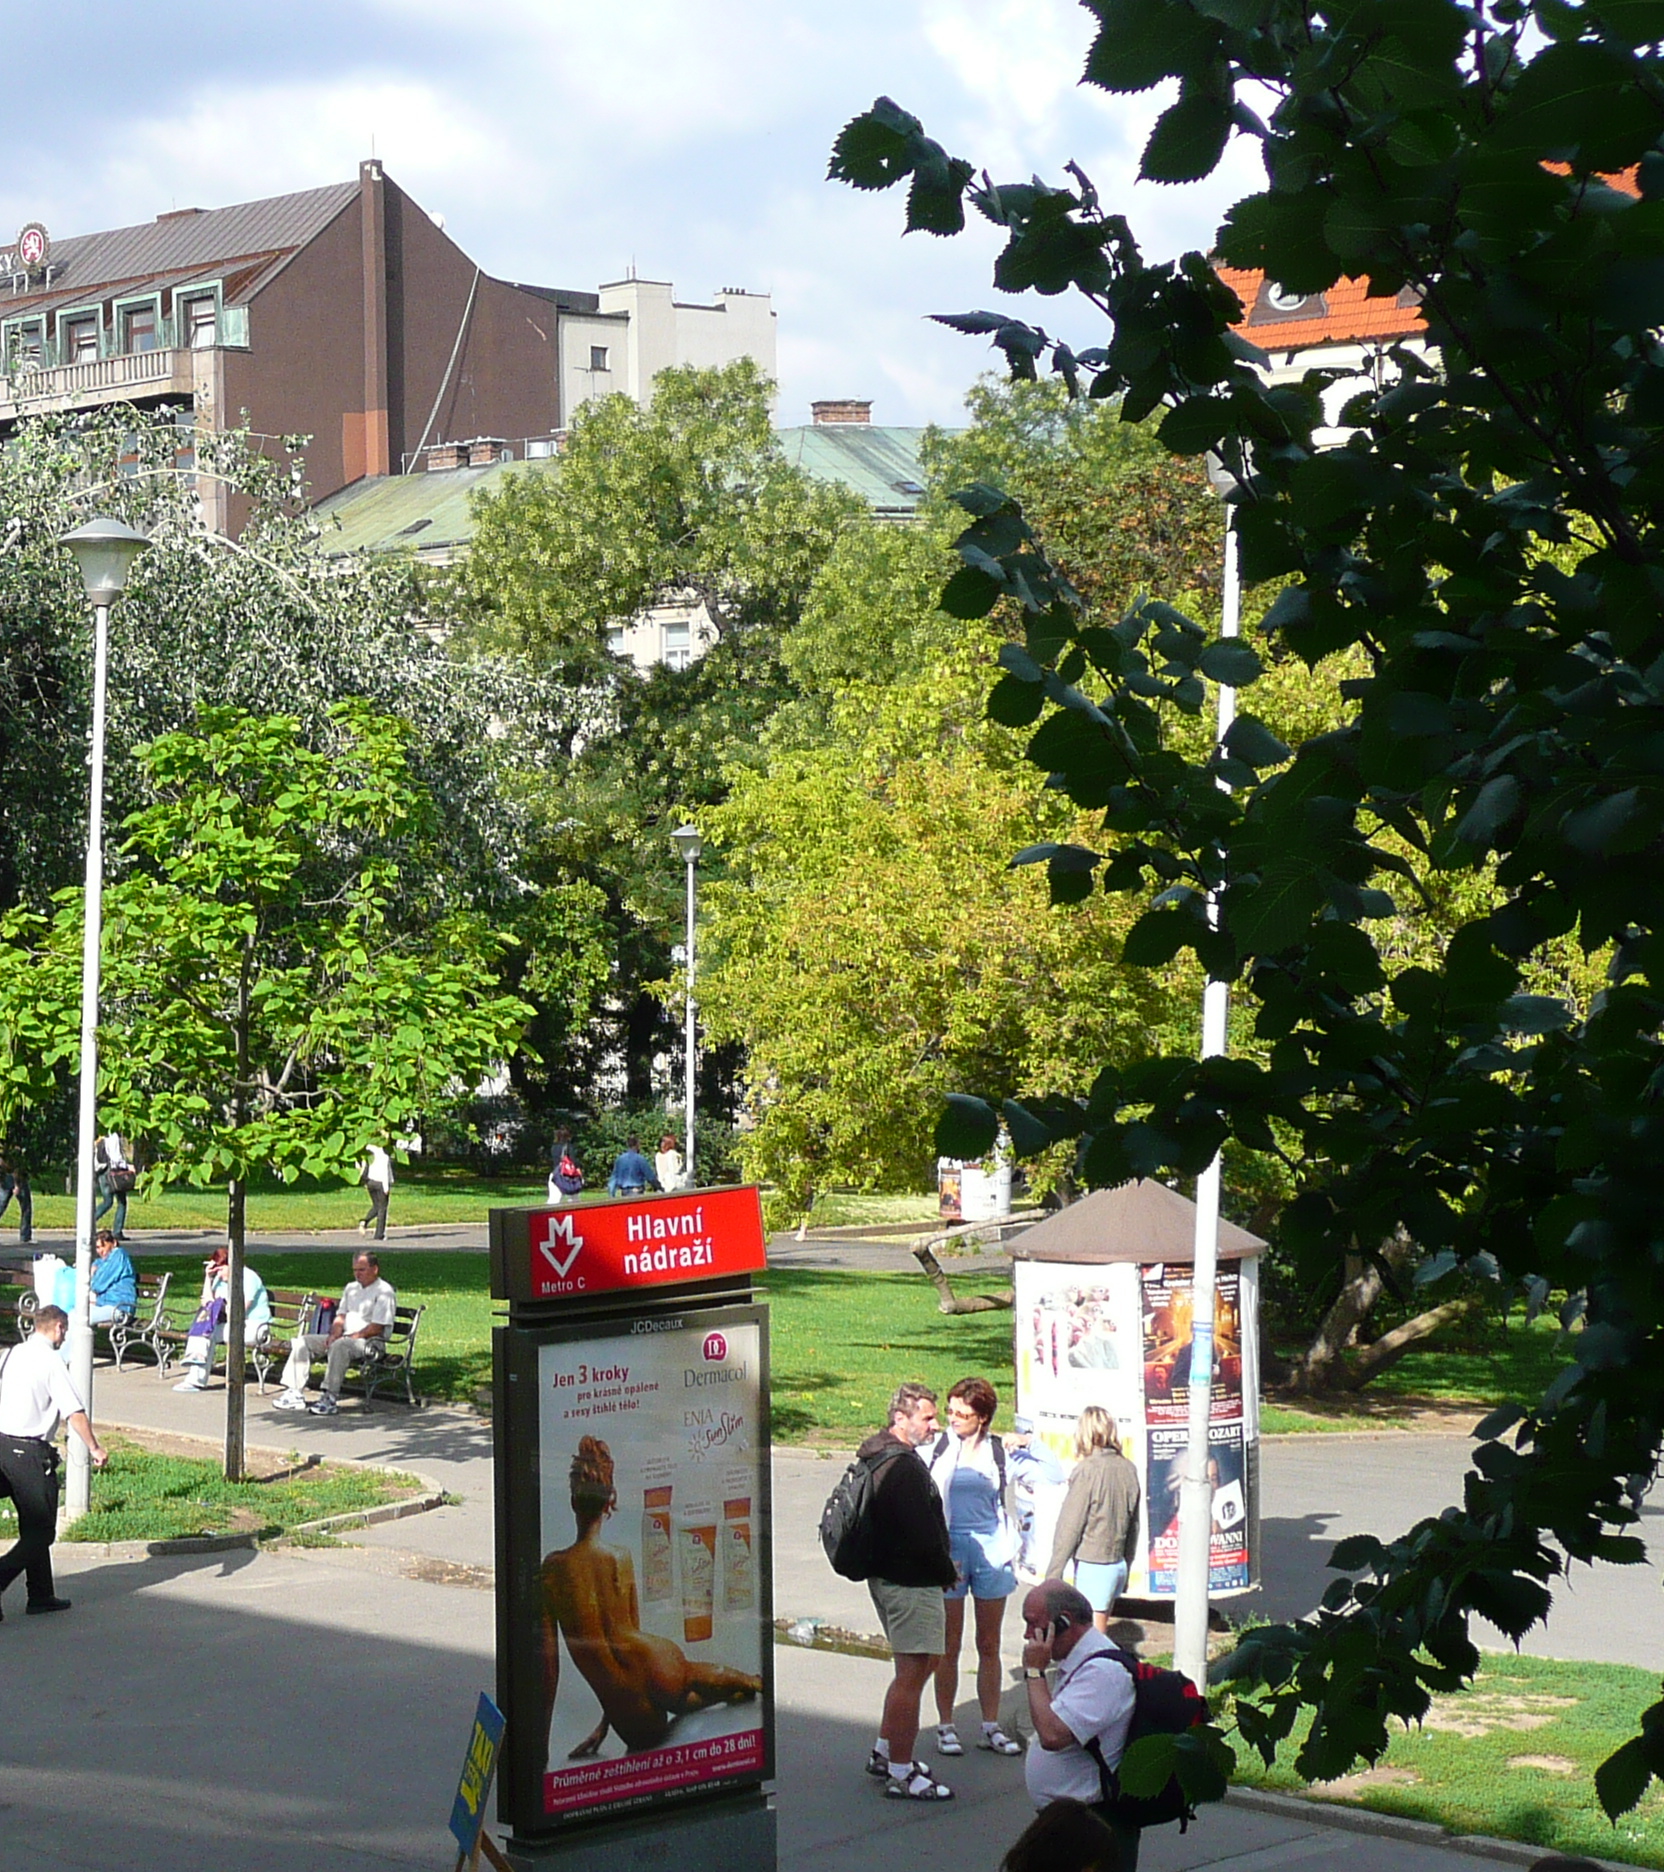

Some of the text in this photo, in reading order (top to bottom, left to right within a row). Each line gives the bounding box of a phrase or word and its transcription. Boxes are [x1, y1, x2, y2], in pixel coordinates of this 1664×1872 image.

[627, 1206, 703, 1242] Hlavní
[624, 1237, 713, 1274] nádraží
[541, 1276, 586, 1294] Metro C
[630, 1318, 684, 1334] JCDecaux
[553, 1365, 630, 1388] Jen 3 kroky
[684, 1360, 747, 1388] Dermacol
[577, 1391, 591, 1403] pro
[563, 1410, 570, 1418] a
[571, 1406, 591, 1419] sexy
[1208, 1426, 1241, 1440] OZART
[553, 1767, 601, 1789] Průměrné
[604, 1757, 651, 1778] zeštíhlení
[652, 1756, 664, 1767] až
[666, 1756, 672, 1765] o
[675, 1748, 690, 1764] 3,1
[693, 1749, 707, 1761] cm
[710, 1742, 722, 1756] do
[724, 1740, 736, 1753] 28
